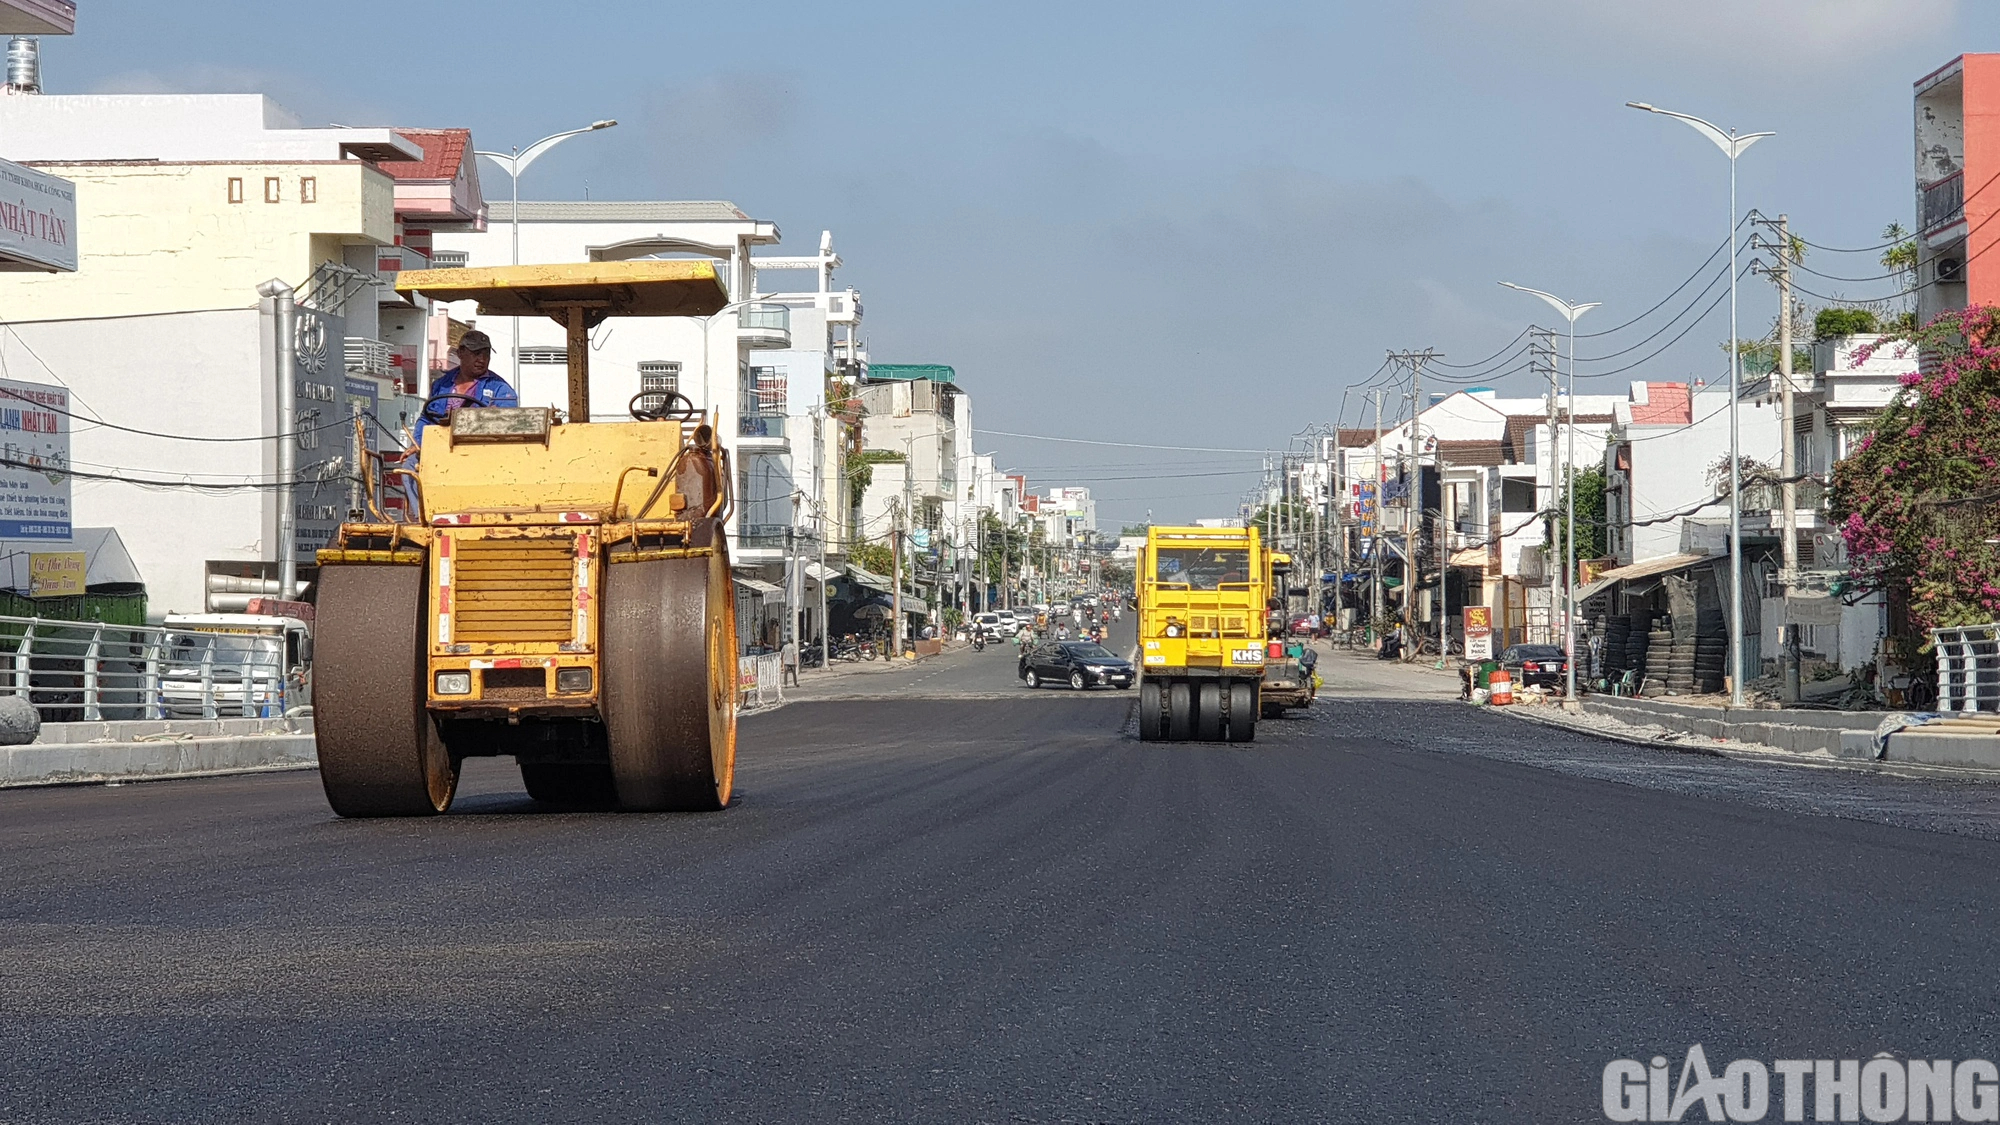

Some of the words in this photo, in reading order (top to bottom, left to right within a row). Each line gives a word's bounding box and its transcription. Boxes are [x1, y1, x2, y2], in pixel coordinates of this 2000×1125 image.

[0, 198, 37, 241] NHẬT
[39, 208, 66, 246] TÂN
[22, 406, 41, 438] NHẬT
[42, 409, 58, 435] TÂN
[1232, 649, 1263, 661] KHS
